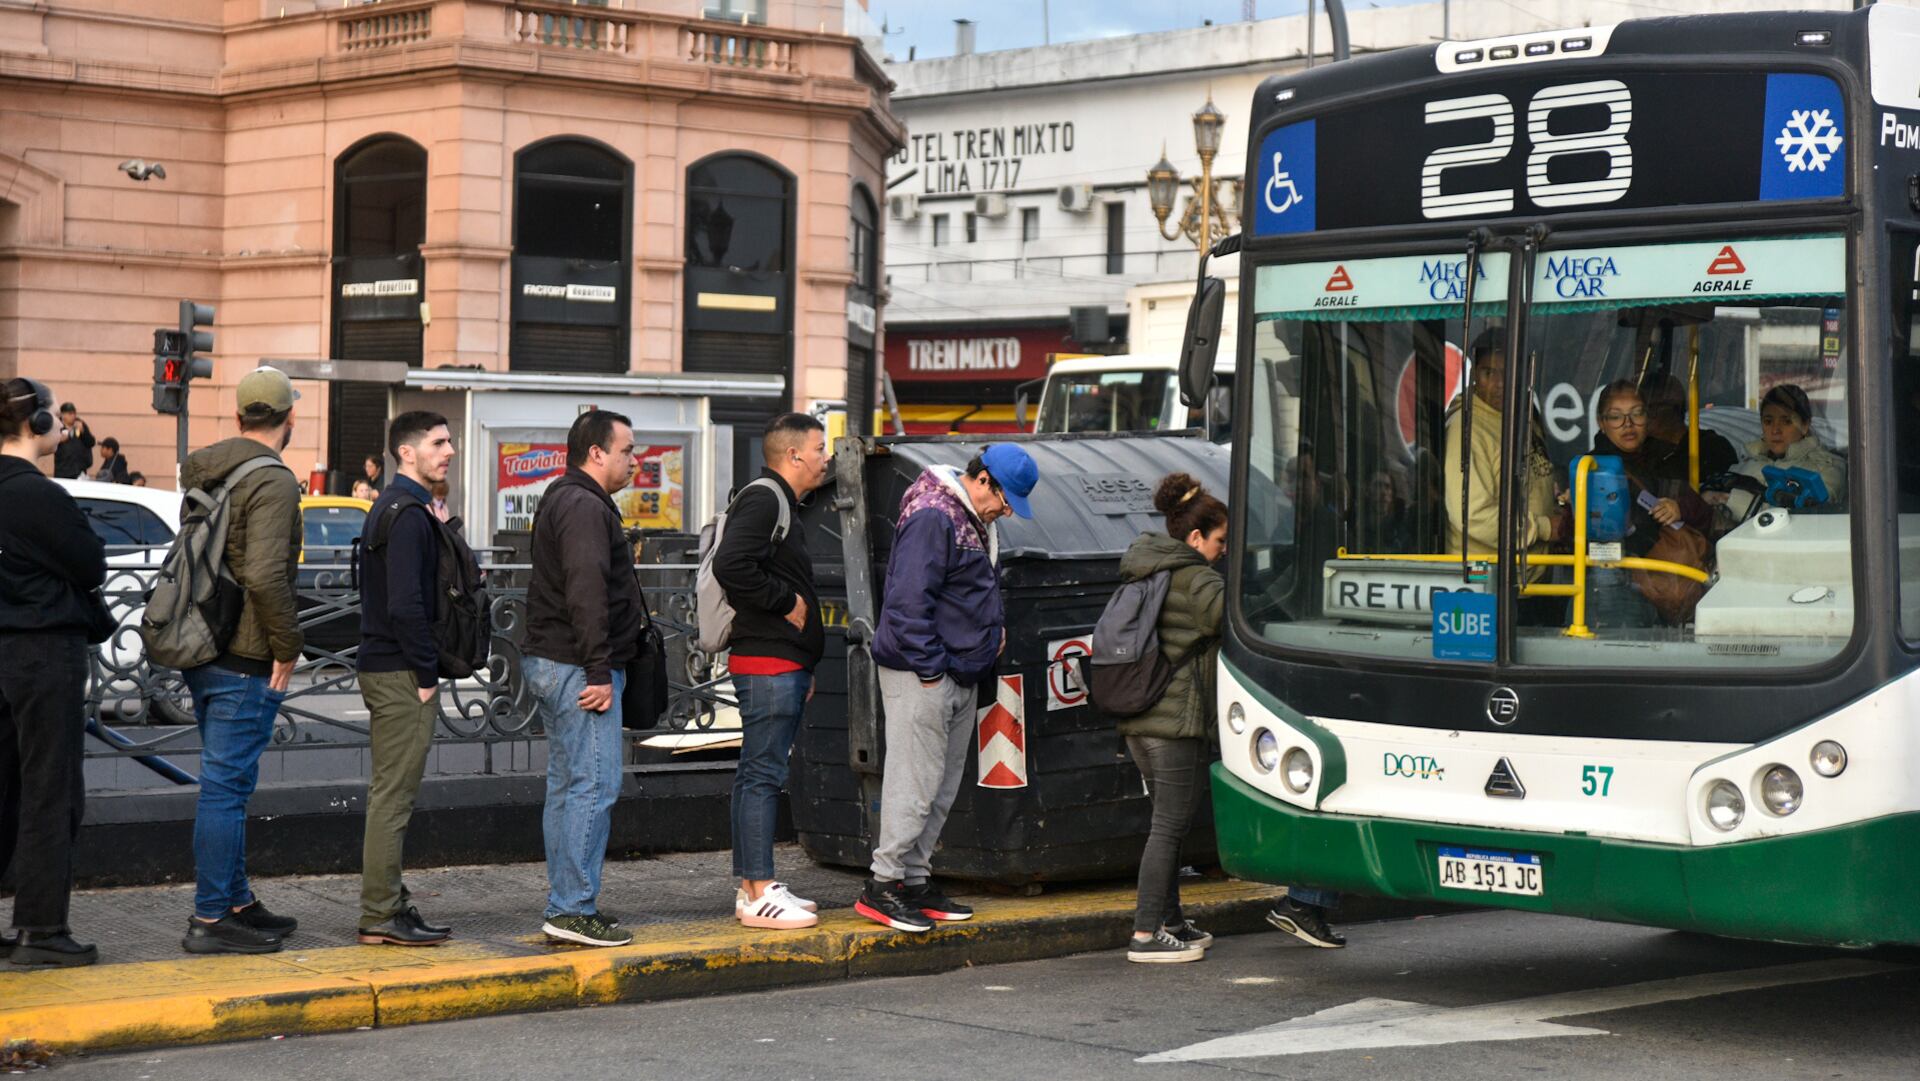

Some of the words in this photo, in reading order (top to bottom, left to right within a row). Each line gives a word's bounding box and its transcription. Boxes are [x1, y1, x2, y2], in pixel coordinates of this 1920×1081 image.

[953, 127, 1004, 160] TREN
[1014, 121, 1074, 156] MIXTO
[1881, 112, 1920, 149] POM
[1421, 79, 1632, 219] 28
[925, 163, 970, 193] LIMA
[982, 158, 1022, 190] 1717
[1545, 255, 1620, 281] MEGA
[1556, 275, 1608, 299] CAR
[1692, 279, 1753, 293] AGRALE
[1314, 295, 1359, 308] AGRALE
[504, 451, 567, 475] Traviata
[1081, 477, 1151, 494] Aesa
[1438, 611, 1491, 636] SUBE
[1384, 753, 1444, 780] DOTA
[1582, 765, 1614, 797] 57
[1443, 861, 1466, 883] AB
[1473, 863, 1507, 888] 151
[1516, 867, 1537, 890] JC
